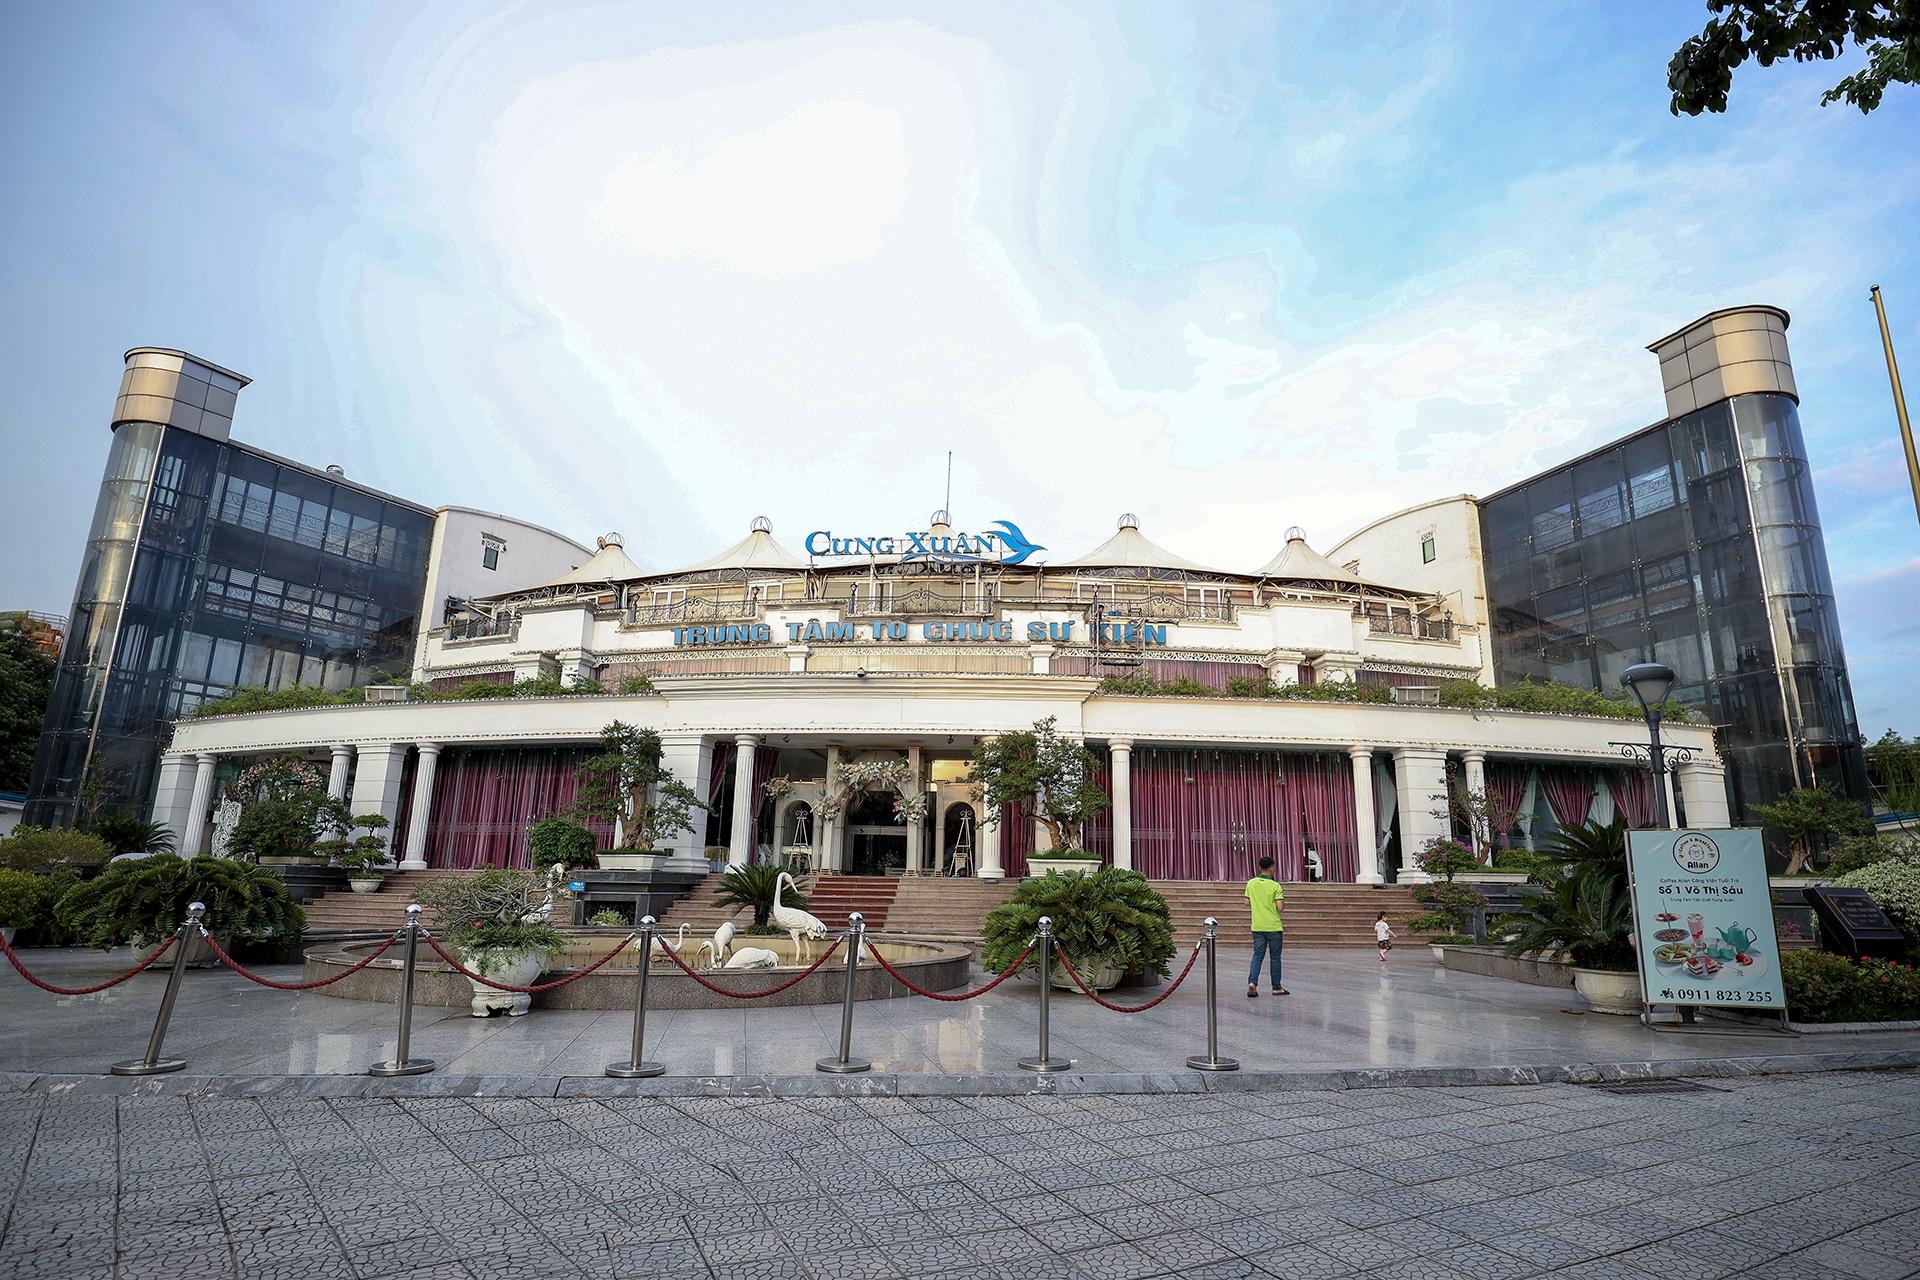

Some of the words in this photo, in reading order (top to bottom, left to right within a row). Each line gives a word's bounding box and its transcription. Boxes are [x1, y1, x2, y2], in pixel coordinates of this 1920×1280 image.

[671, 623, 771, 645] TRUNG
[786, 618, 855, 641] TÂM
[1658, 884, 1673, 894] Số
[1675, 886, 1681, 894] 1
[1685, 886, 1701, 894] Võ
[1703, 886, 1719, 897] Thị
[1722, 885, 1744, 895] Sáu
[1678, 989, 1710, 1000] 0911
[1716, 990, 1742, 1001] 823
[1746, 991, 1773, 1002] 255
